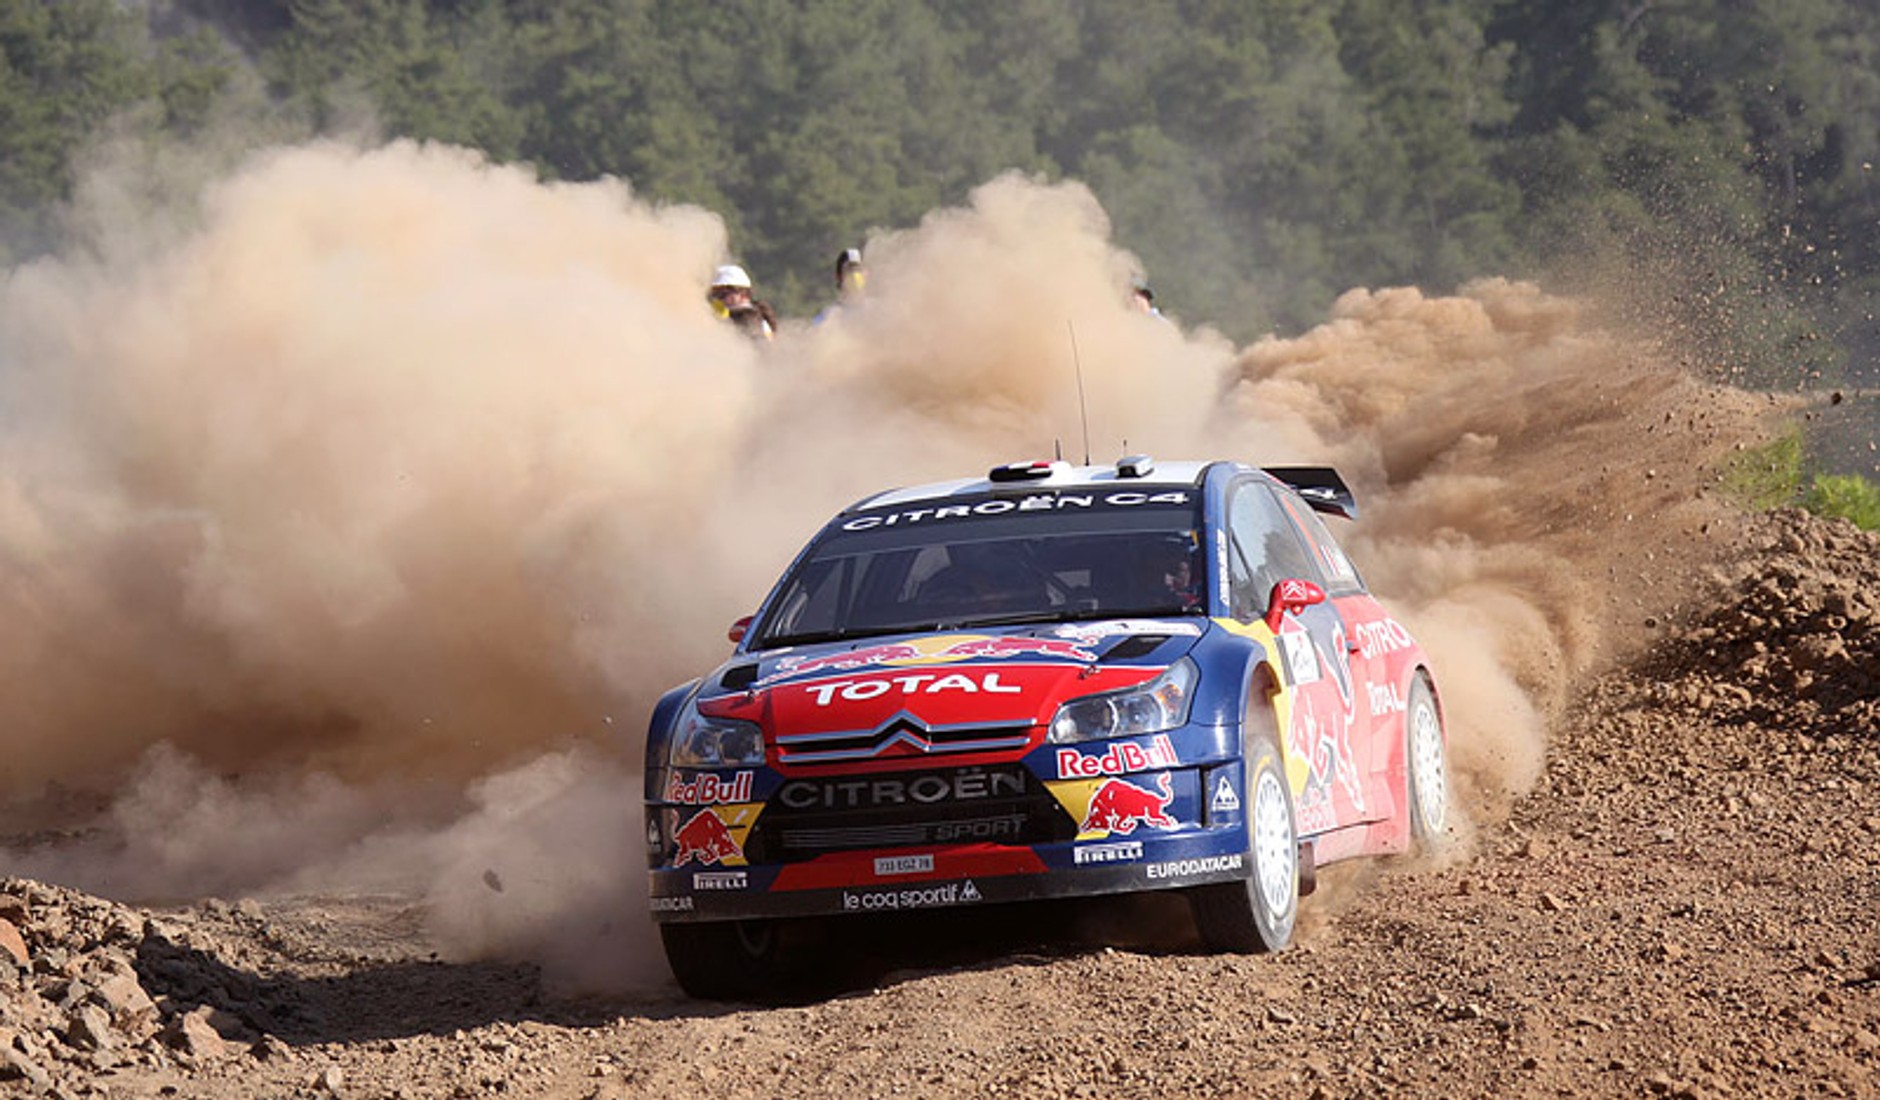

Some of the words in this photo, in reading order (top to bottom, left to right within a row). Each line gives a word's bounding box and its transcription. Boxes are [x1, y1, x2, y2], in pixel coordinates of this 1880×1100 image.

[843, 494, 1093, 531] CITROËN
[1104, 491, 1190, 505] C4
[805, 672, 1022, 706] TOTAL
[1057, 741, 1124, 778] Red
[1119, 734, 1179, 772] Bull
[699, 771, 753, 804] Bull
[779, 767, 1027, 808] CITROËN
[935, 814, 1029, 840] SPORT
[1074, 841, 1144, 865] PIRELLI
[1147, 854, 1243, 879] EURODATACAR
[693, 872, 748, 890] PIRELLI
[843, 890, 860, 909] le
[862, 893, 898, 909] coq
[900, 884, 958, 908] sportif
